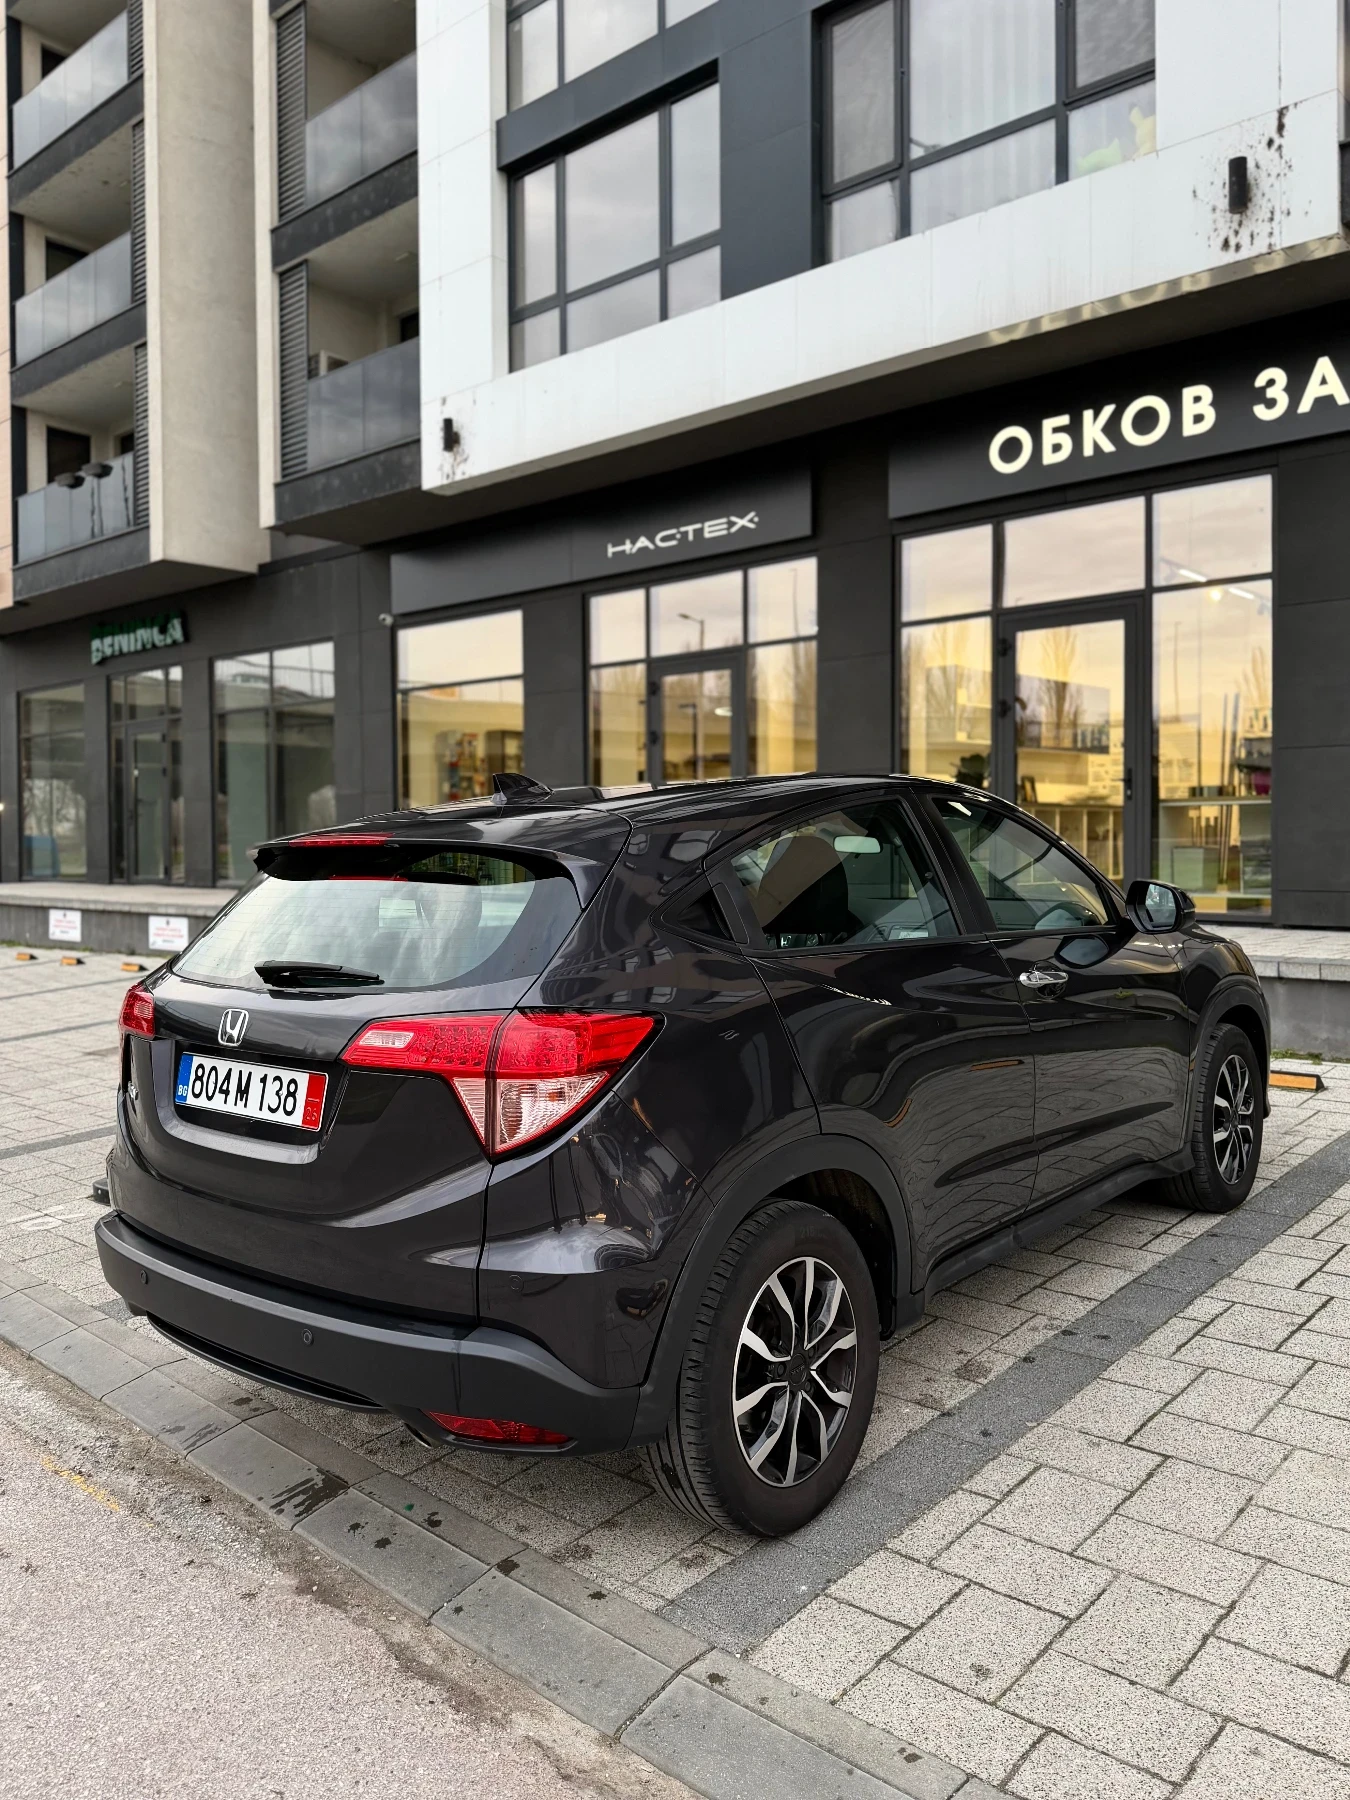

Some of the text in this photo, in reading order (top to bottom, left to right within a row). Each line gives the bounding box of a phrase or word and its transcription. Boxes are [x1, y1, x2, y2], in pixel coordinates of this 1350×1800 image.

[988, 356, 1350, 474] ОБКОВ ЗА
[177, 1085, 188, 1096] BG
